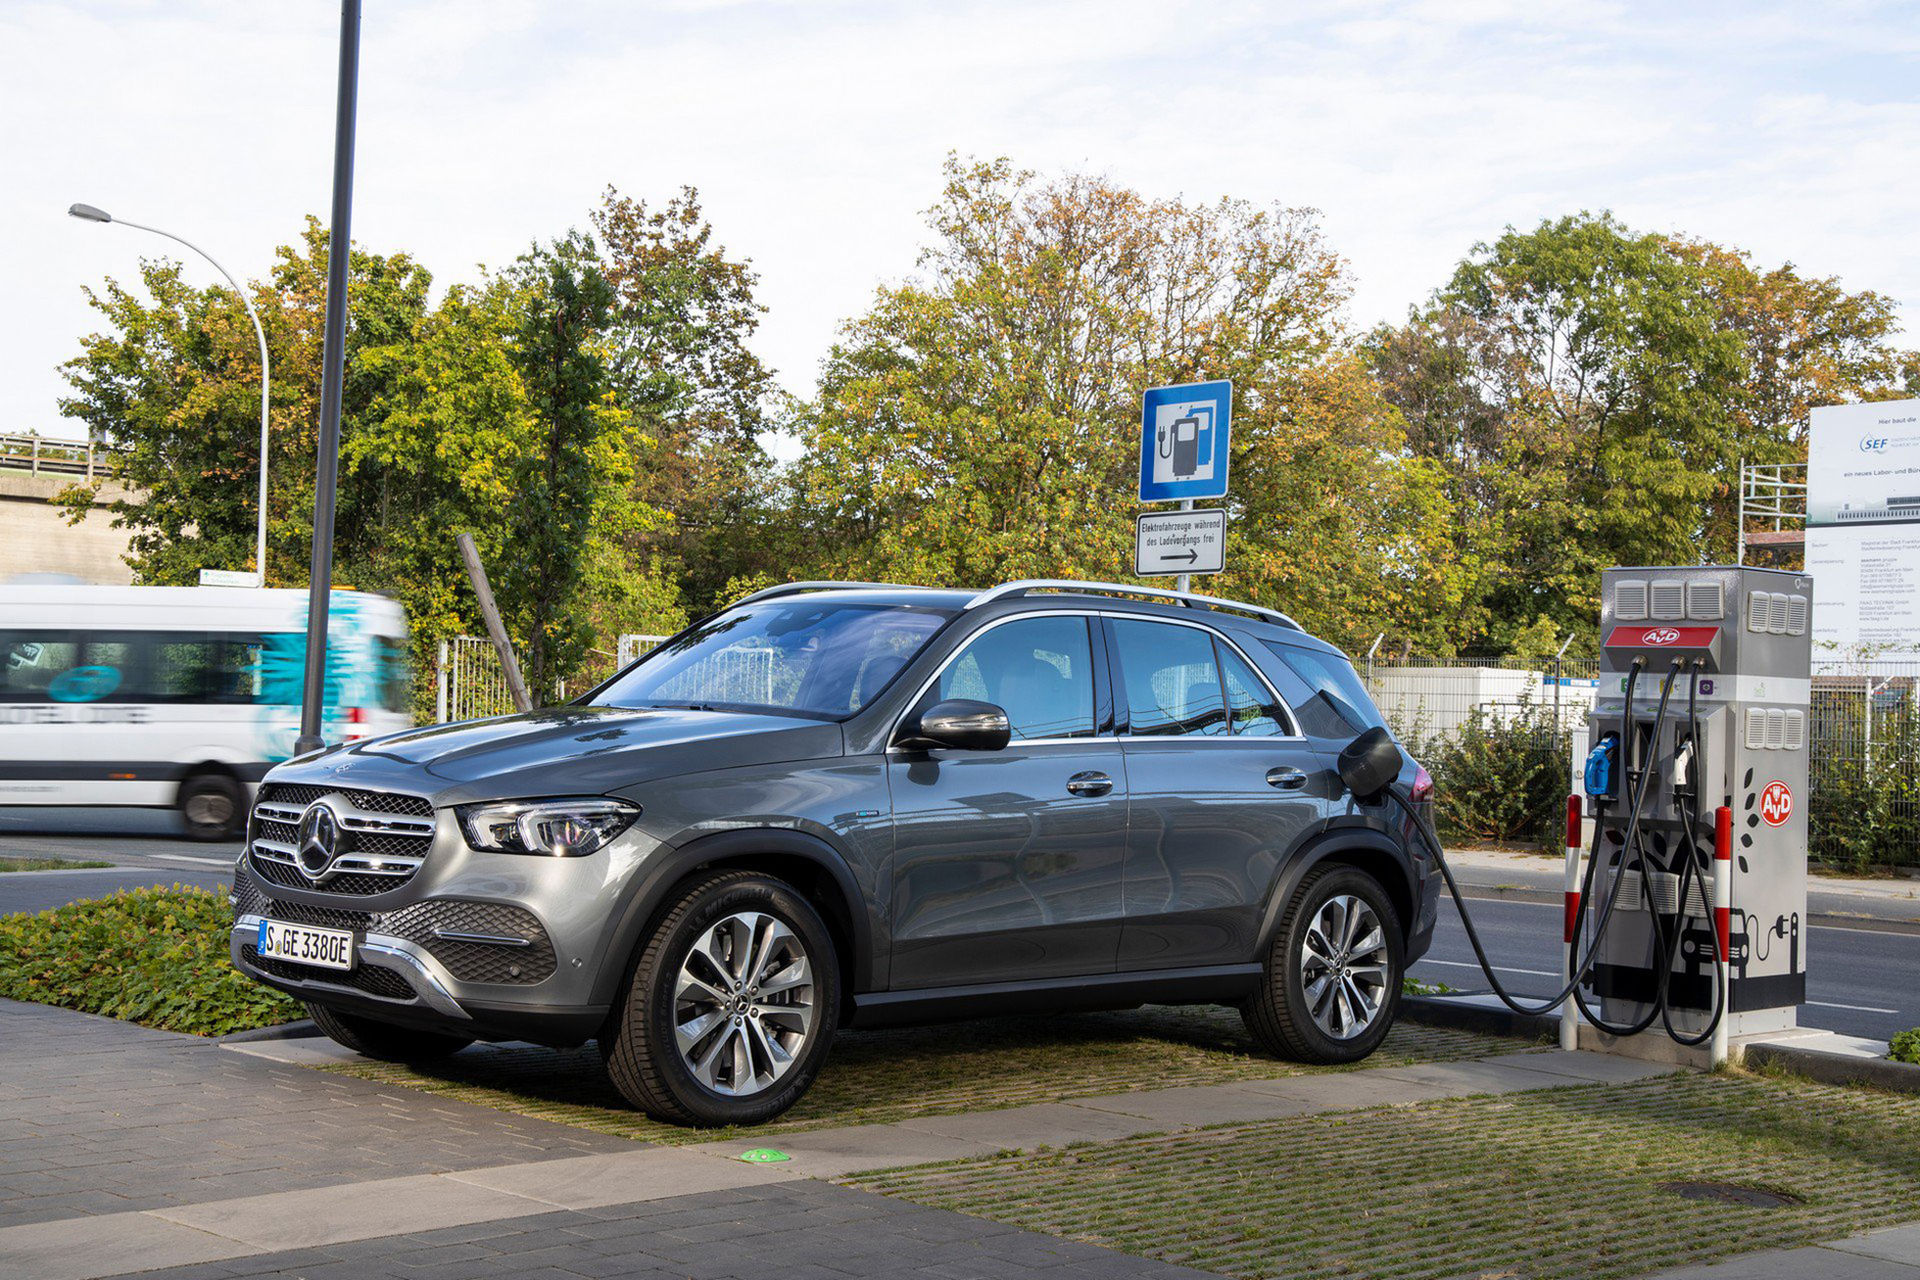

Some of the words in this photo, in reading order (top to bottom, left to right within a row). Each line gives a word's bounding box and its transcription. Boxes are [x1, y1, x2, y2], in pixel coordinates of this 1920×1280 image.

[1865, 438, 1888, 449] SEF
[1142, 522, 1191, 532] Elektrofahrzeuge
[1194, 519, 1220, 529] während
[1146, 536, 1157, 546] des
[1159, 534, 1201, 546] Ladevorgangs
[1203, 533, 1215, 544] frei
[266, 926, 275, 952] S
[283, 929, 299, 957] GE
[302, 933, 348, 963] 3380E
